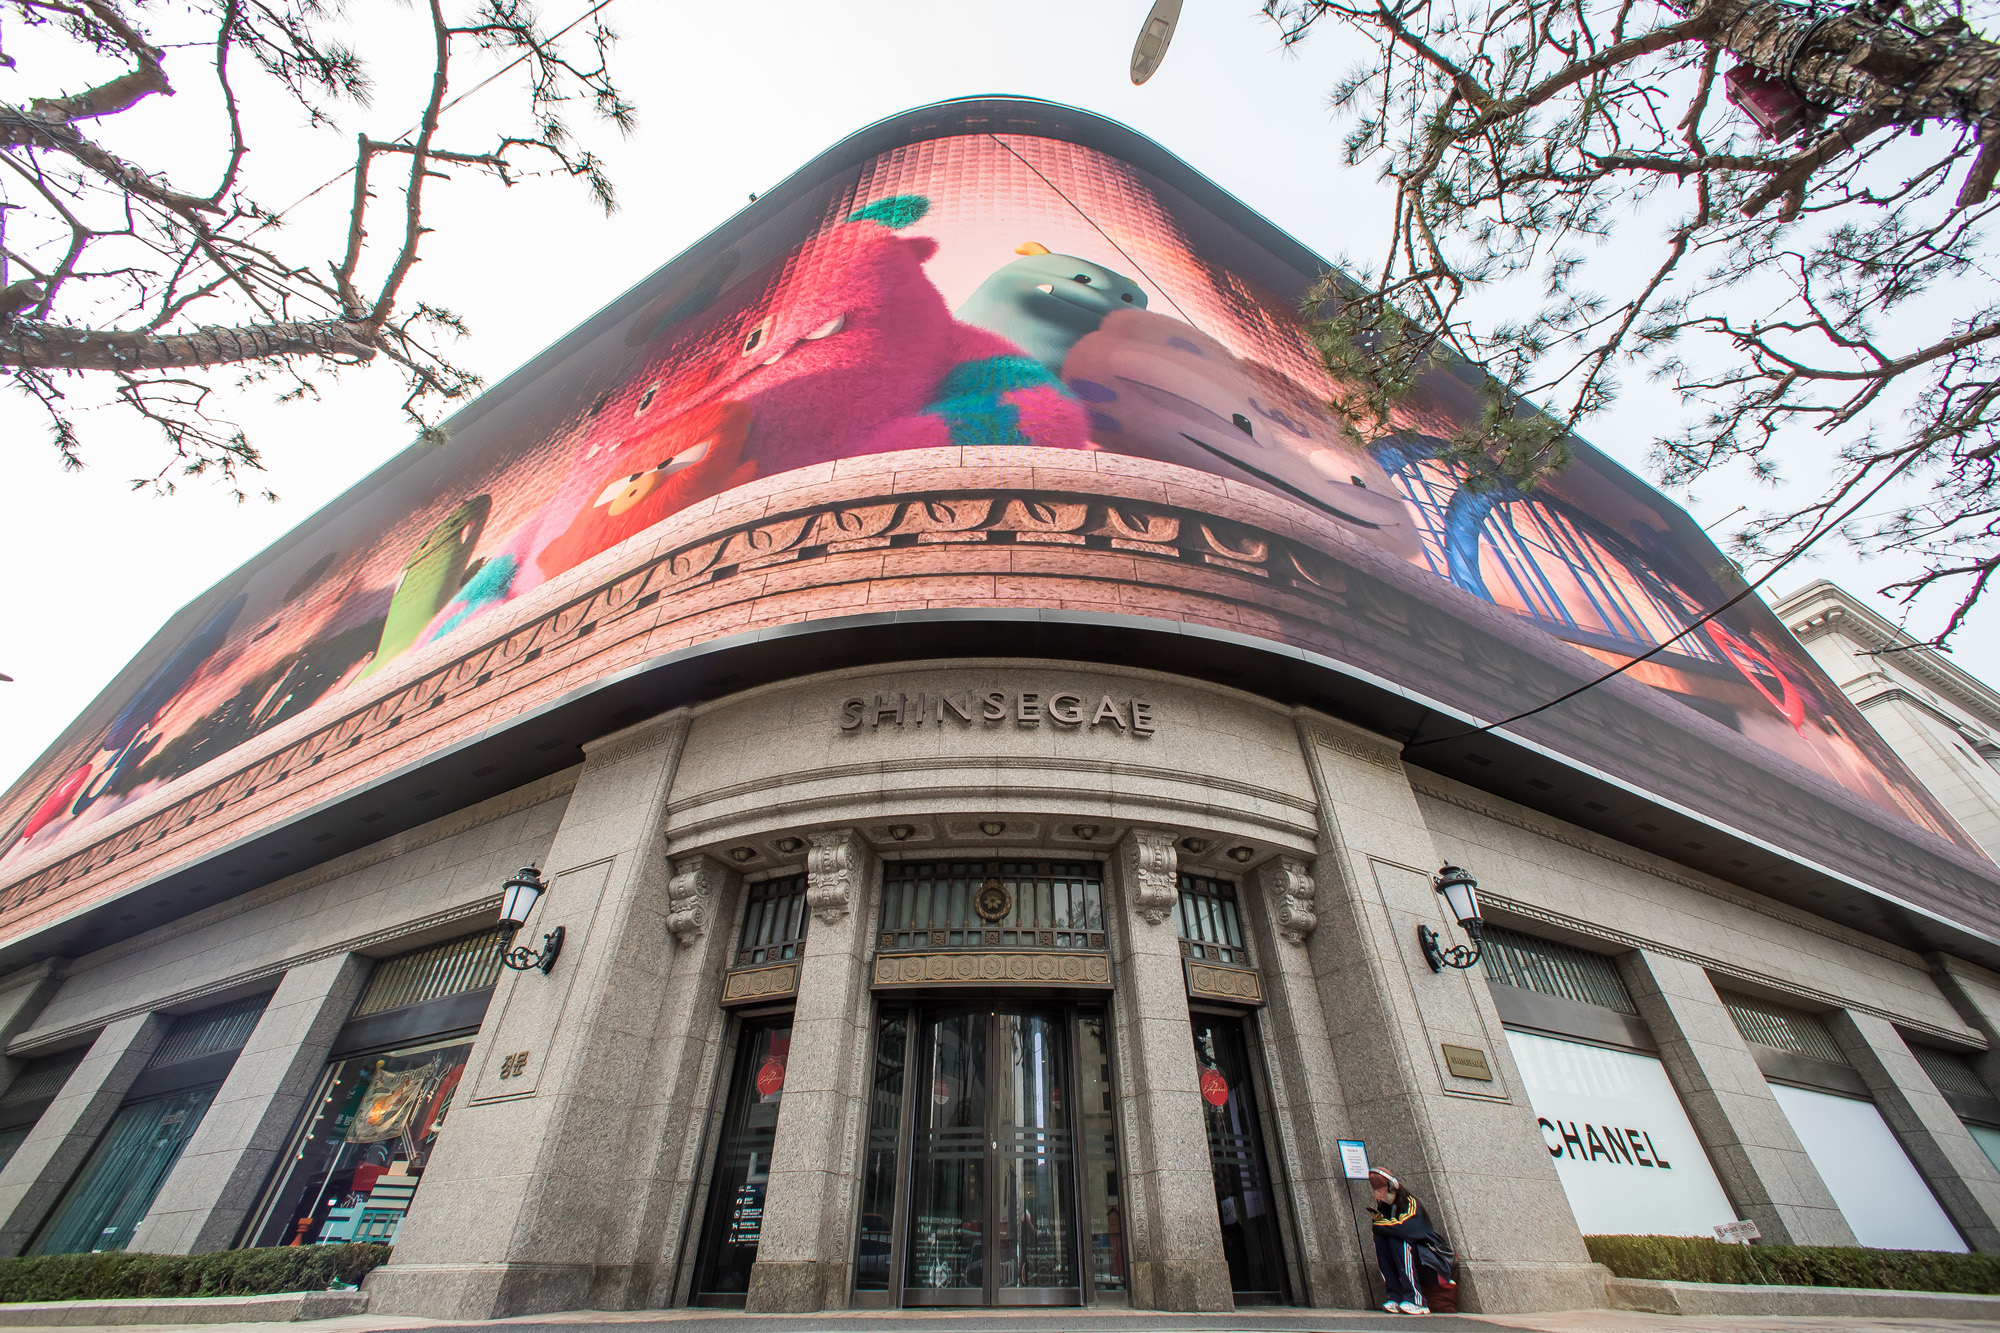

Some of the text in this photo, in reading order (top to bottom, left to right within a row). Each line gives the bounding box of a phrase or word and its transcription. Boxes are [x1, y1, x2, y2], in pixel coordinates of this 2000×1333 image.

[840, 691, 1155, 734] SHINSEGAE
[500, 1051, 529, 1079] 정문
[1537, 1117, 1672, 1170] CHANEL
